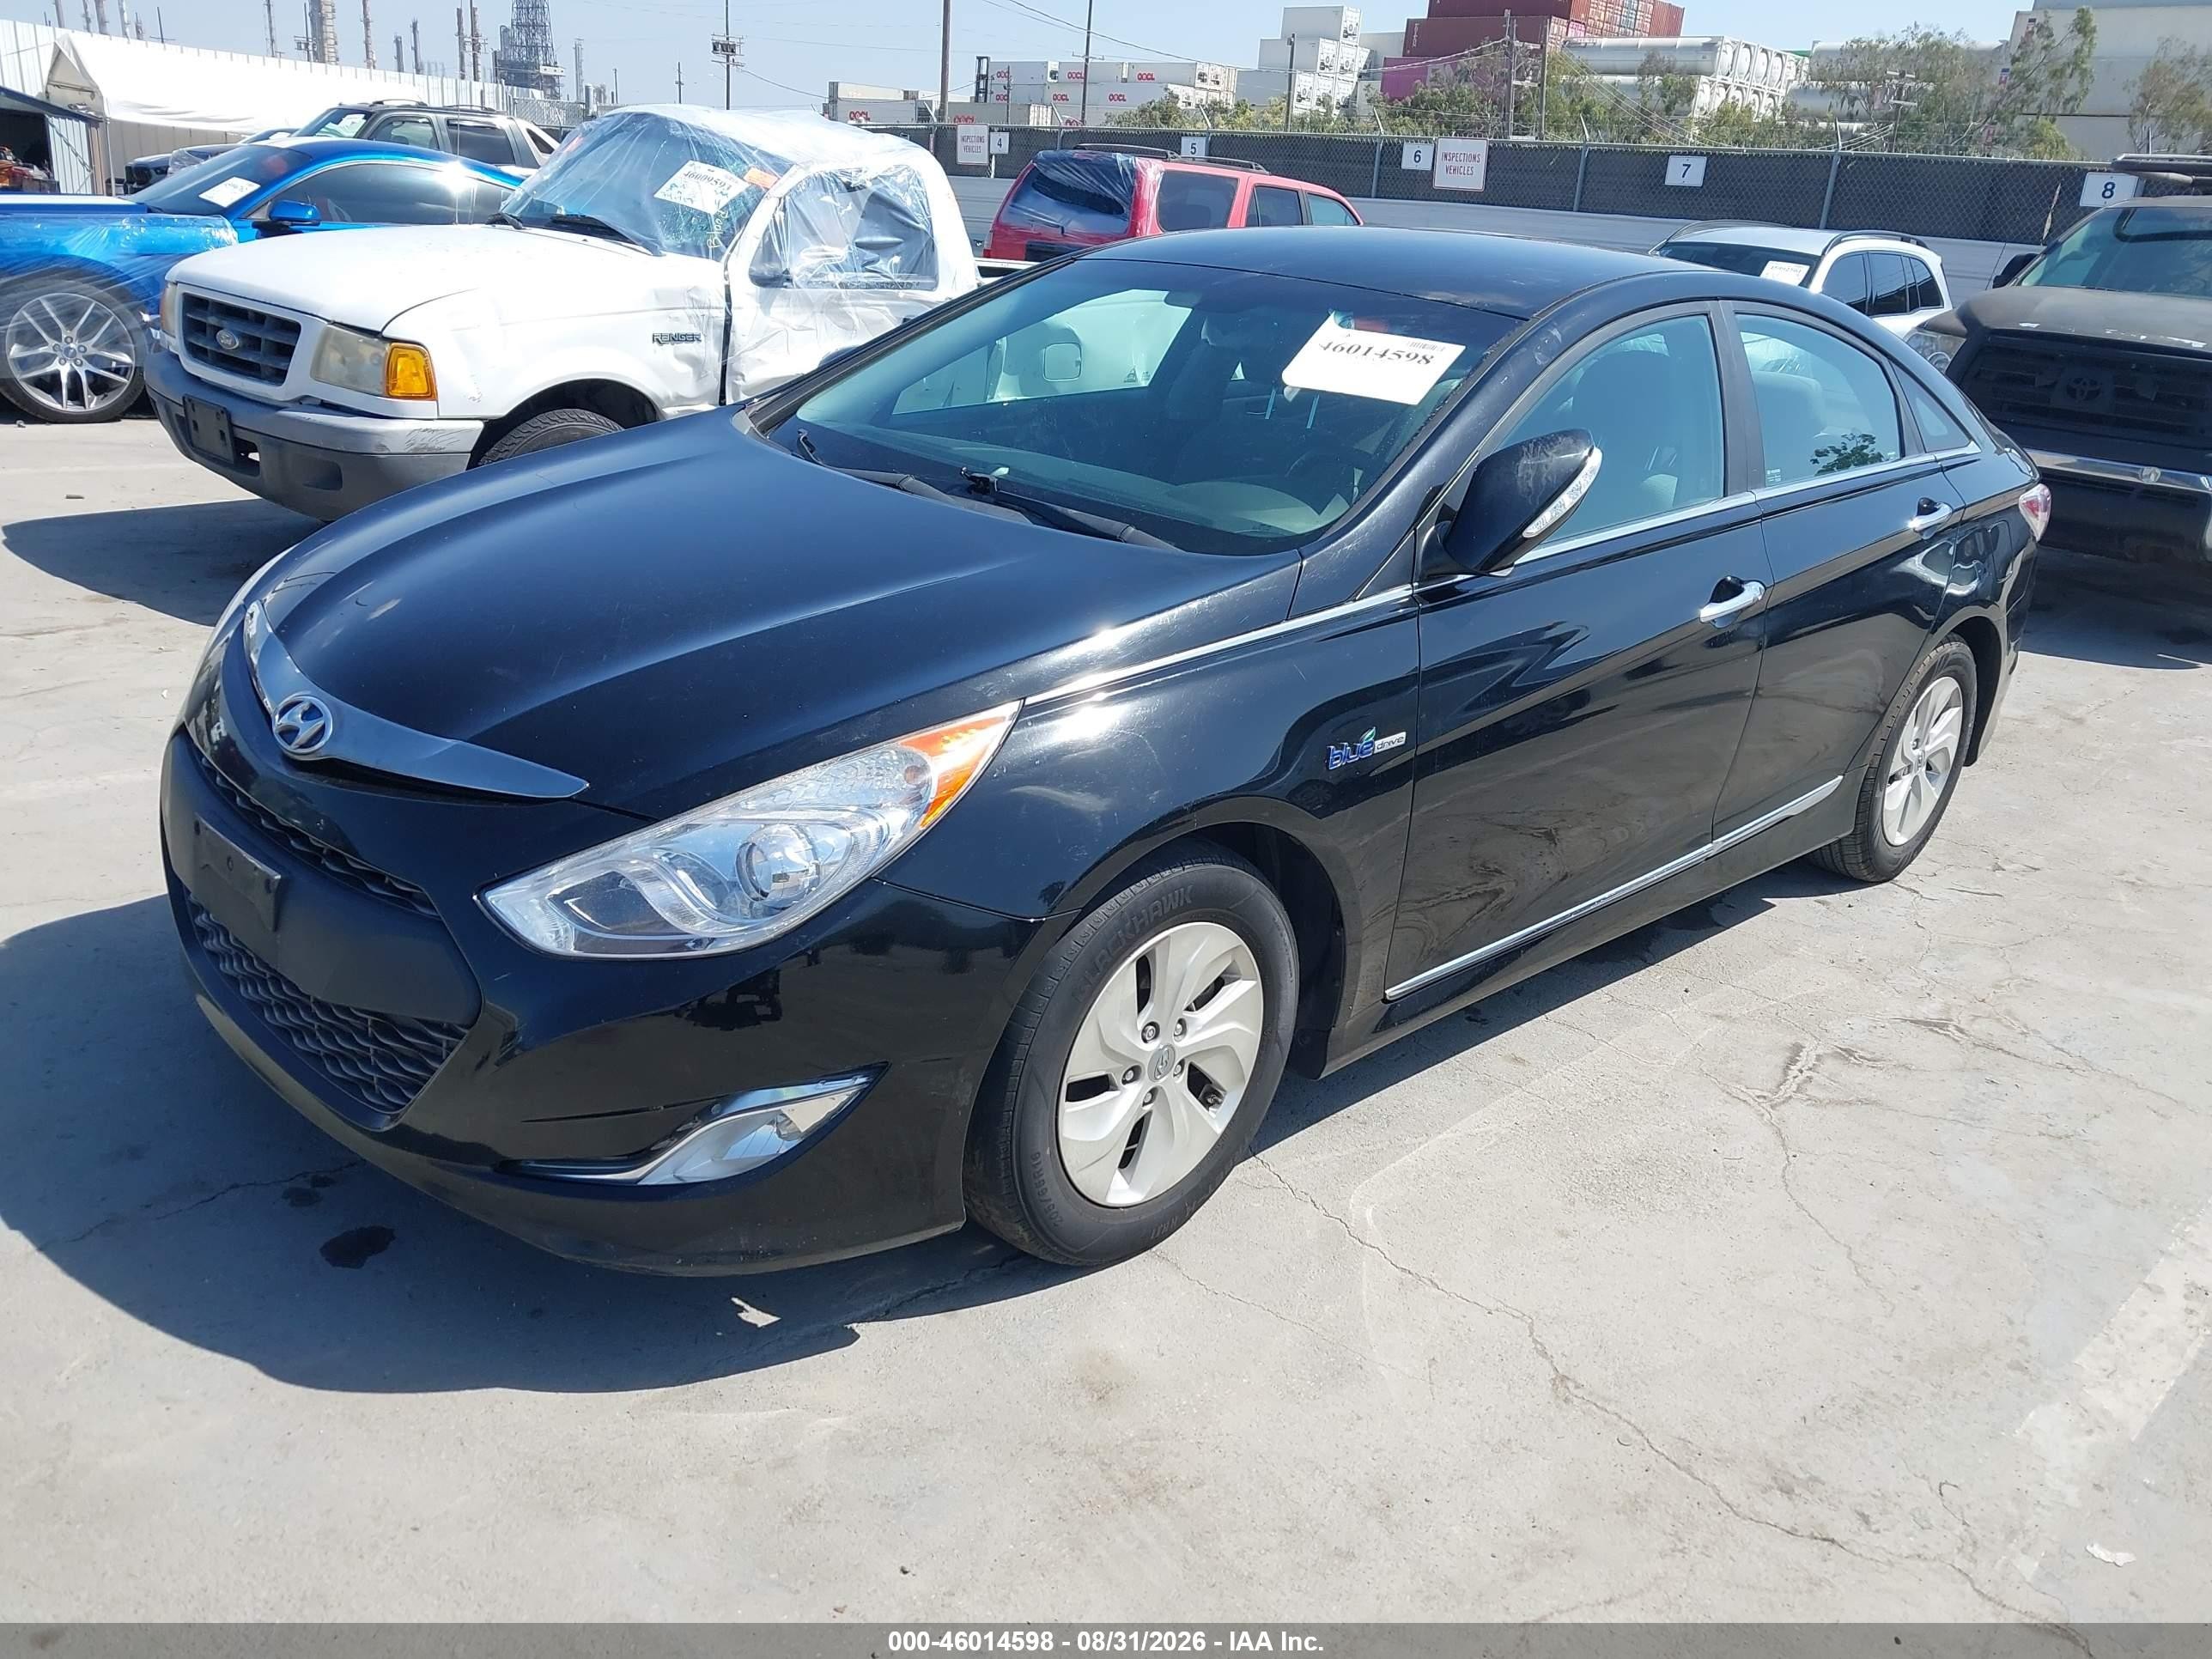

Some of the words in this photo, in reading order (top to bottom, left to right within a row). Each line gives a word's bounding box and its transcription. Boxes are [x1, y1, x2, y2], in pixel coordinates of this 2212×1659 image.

[1137, 72, 1155, 81] OOCL
[1053, 93, 1069, 101] OOCL
[1109, 93, 1127, 101] OOCL
[961, 135, 985, 144] INSPECTIONS
[997, 137, 1002, 149] 4
[963, 145, 981, 154] VEHICLES
[1190, 143, 1197, 155] 5
[1413, 149, 1422, 163] 6
[1441, 151, 1481, 163] INSPECTIONS
[1445, 164, 1474, 176] VEHICLES
[1681, 163, 1692, 179] 7
[2101, 181, 2116, 199] 8
[652, 332, 702, 345] RANGER
[1318, 341, 1435, 366] 46014598
[1376, 736, 1405, 750] drive
